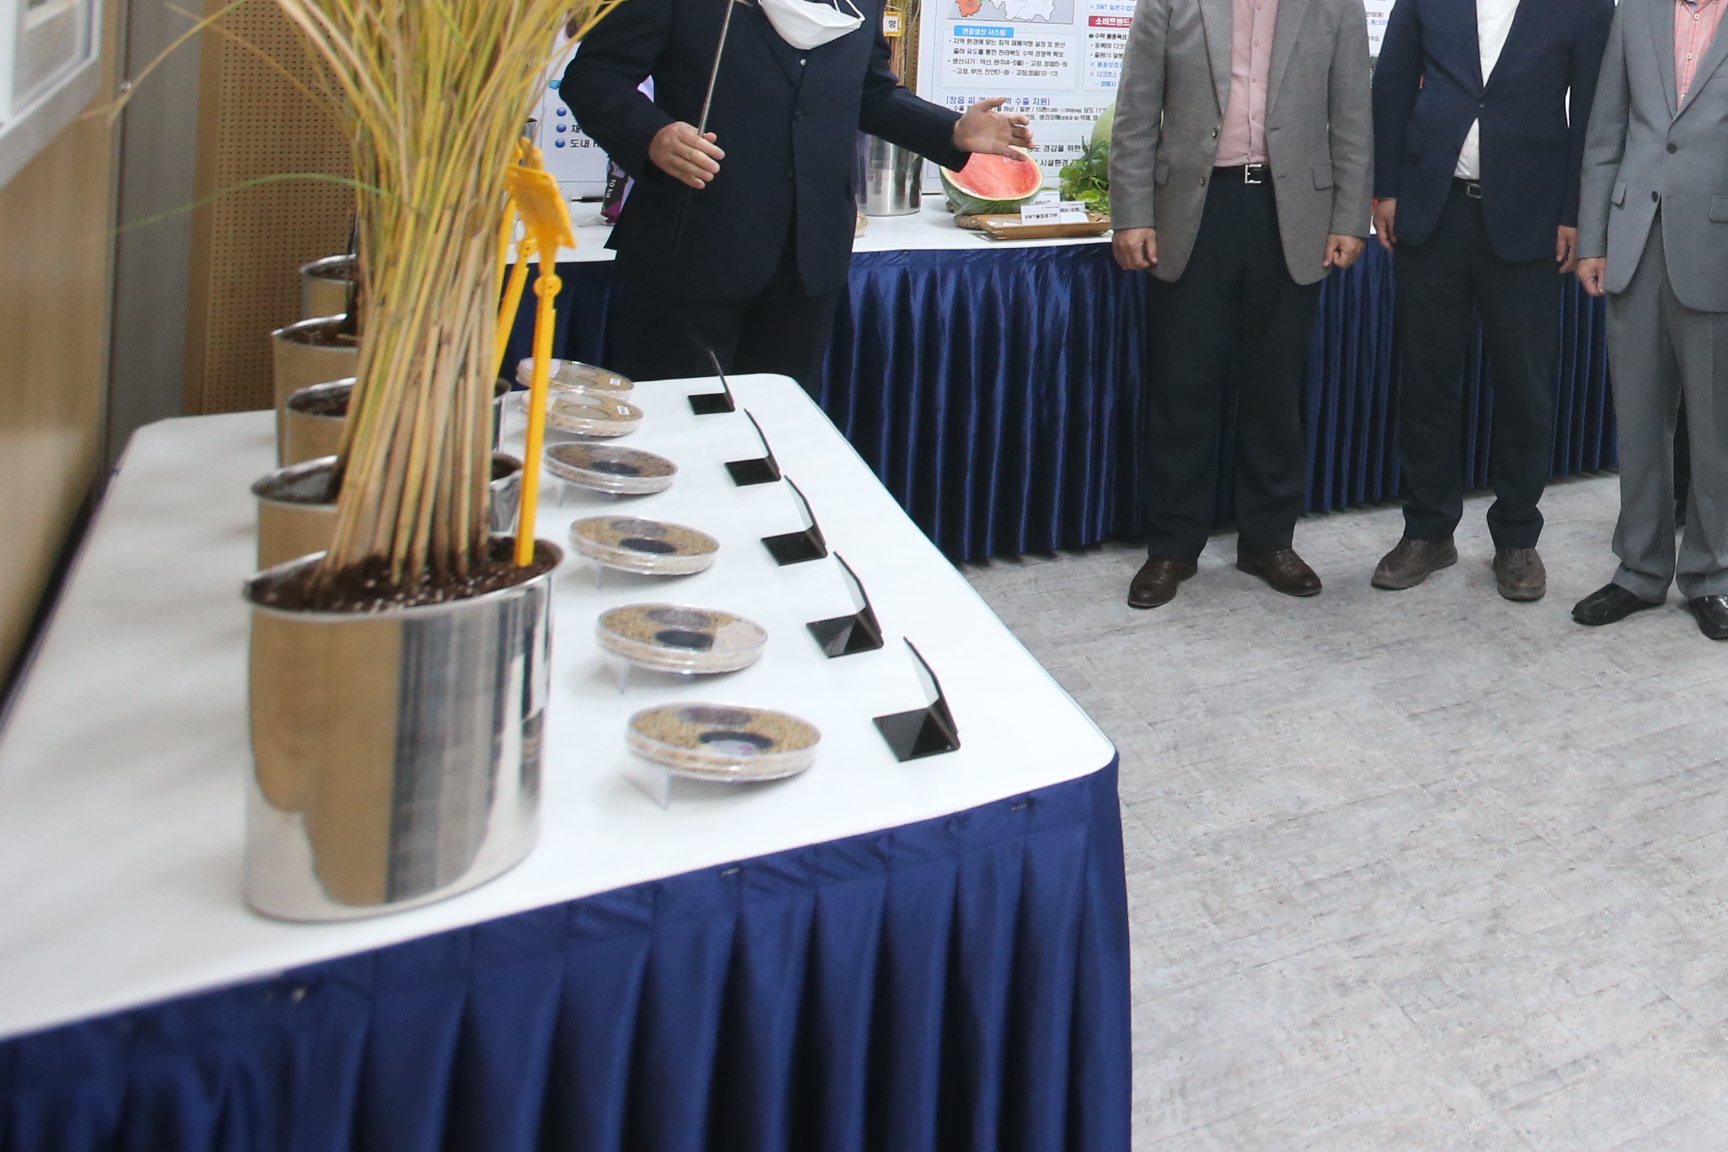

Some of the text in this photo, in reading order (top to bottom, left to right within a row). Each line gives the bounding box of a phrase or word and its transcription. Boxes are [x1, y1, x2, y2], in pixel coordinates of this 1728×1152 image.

[1095, 17, 1131, 27] 소비트렌드
[570, 139, 590, 148] 도내
[1067, 145, 1081, 153] 위한
[1039, 158, 1068, 167] 시설환경
